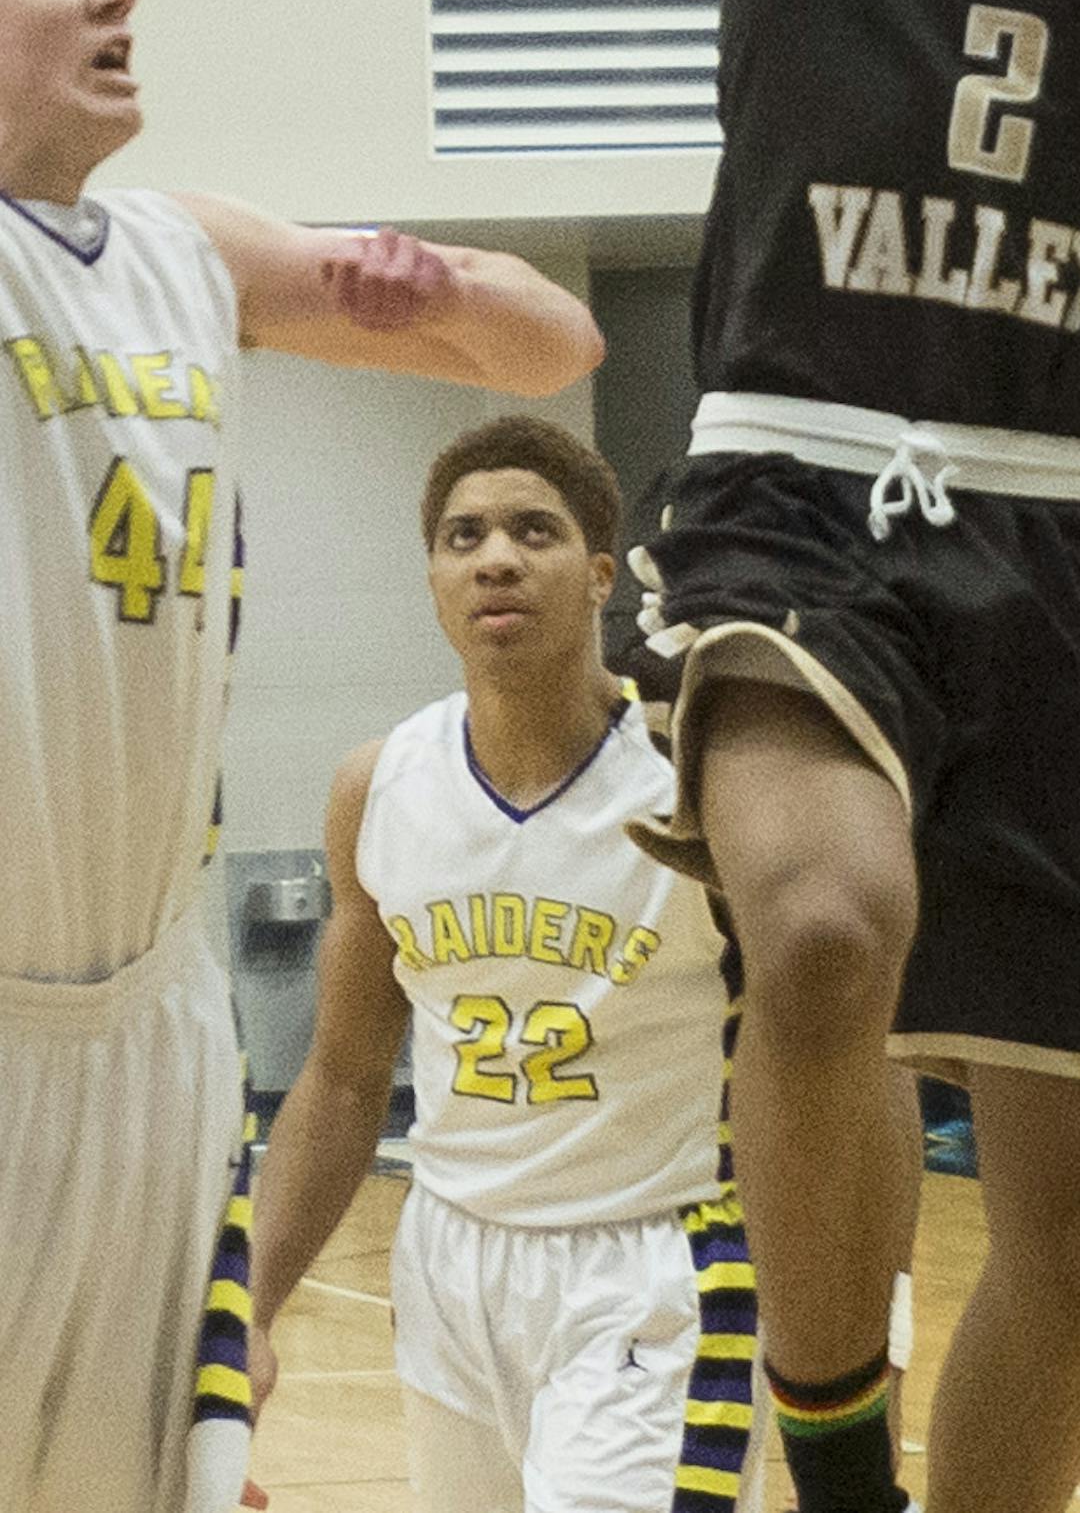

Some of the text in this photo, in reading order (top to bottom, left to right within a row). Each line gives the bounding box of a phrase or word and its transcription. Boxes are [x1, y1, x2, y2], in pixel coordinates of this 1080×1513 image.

[947, 3, 1050, 183] 2
[389, 892, 662, 986] RAIDERS
[451, 994, 599, 1104] 22
